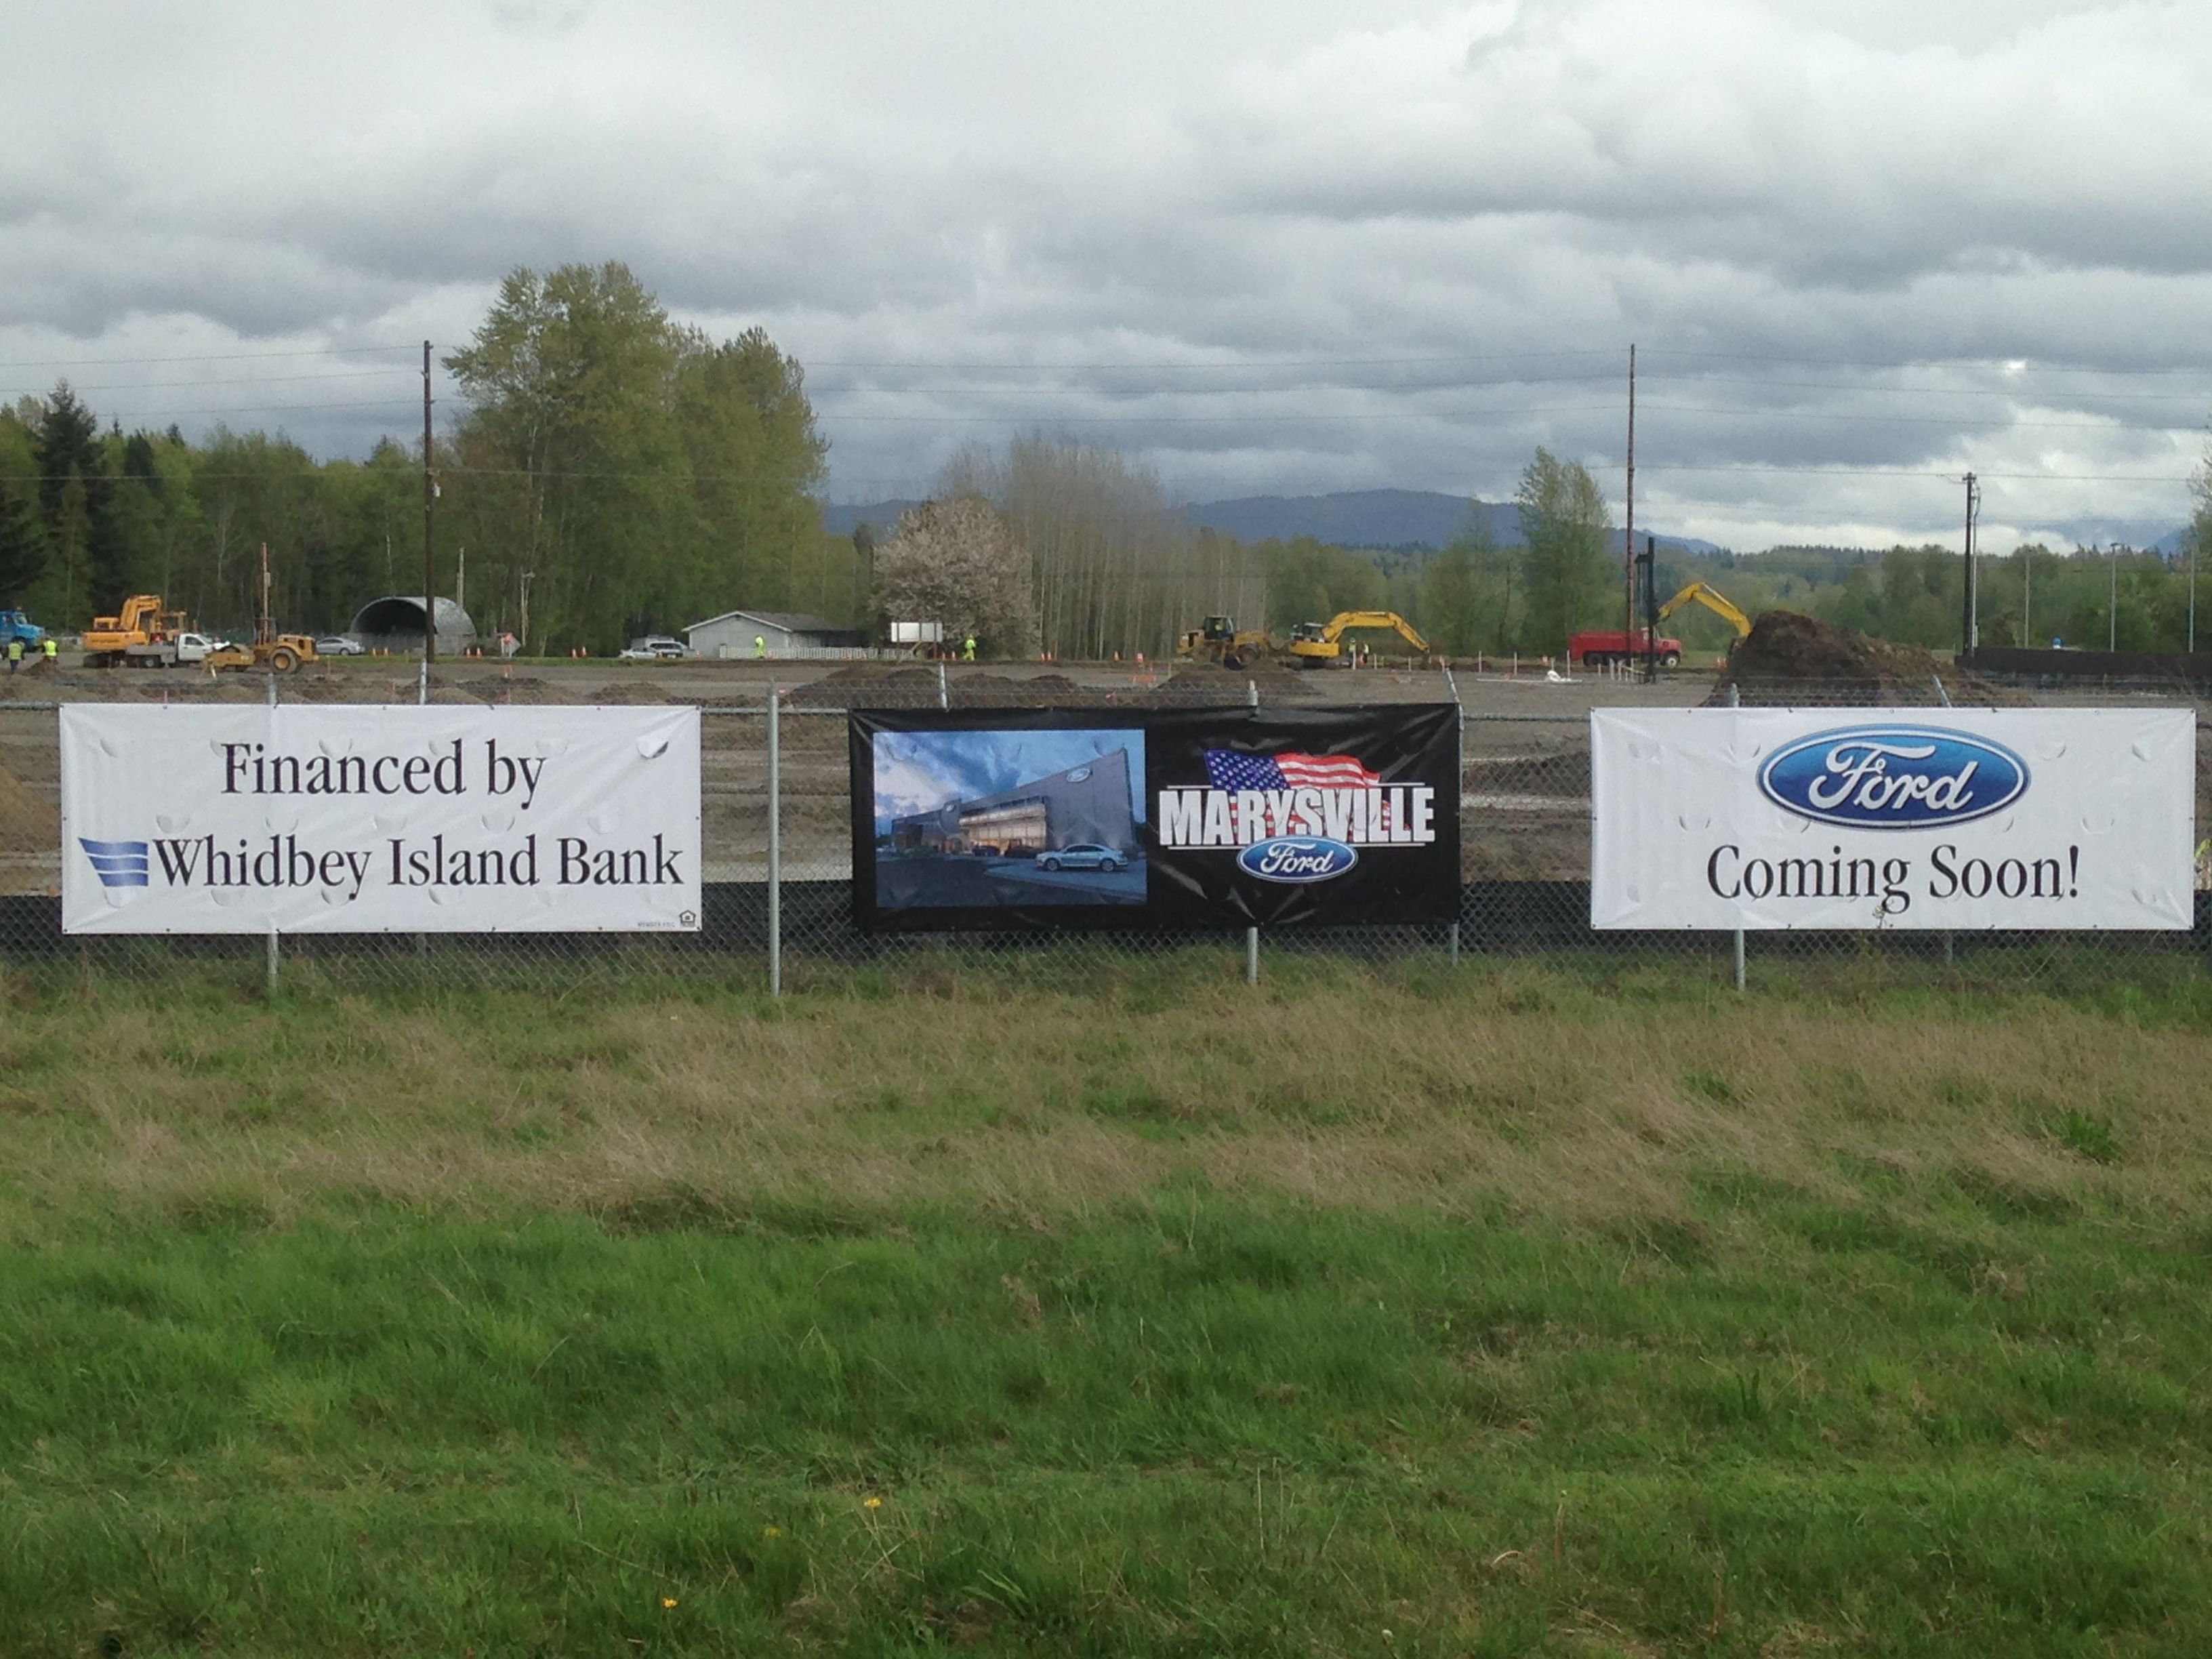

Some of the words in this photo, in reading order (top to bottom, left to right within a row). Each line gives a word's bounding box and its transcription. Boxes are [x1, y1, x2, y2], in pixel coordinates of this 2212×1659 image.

[221, 739, 466, 796] Financed
[487, 739, 547, 811] by
[1808, 741, 1978, 811] Ford
[1159, 787, 1435, 845] MARYSVILLE
[153, 834, 371, 901] Whidbey
[387, 834, 540, 886] Island
[556, 834, 684, 886] Bank
[1259, 842, 1334, 874] Ford
[1707, 844, 1911, 914] Coming
[1929, 844, 2079, 899] Soon!
